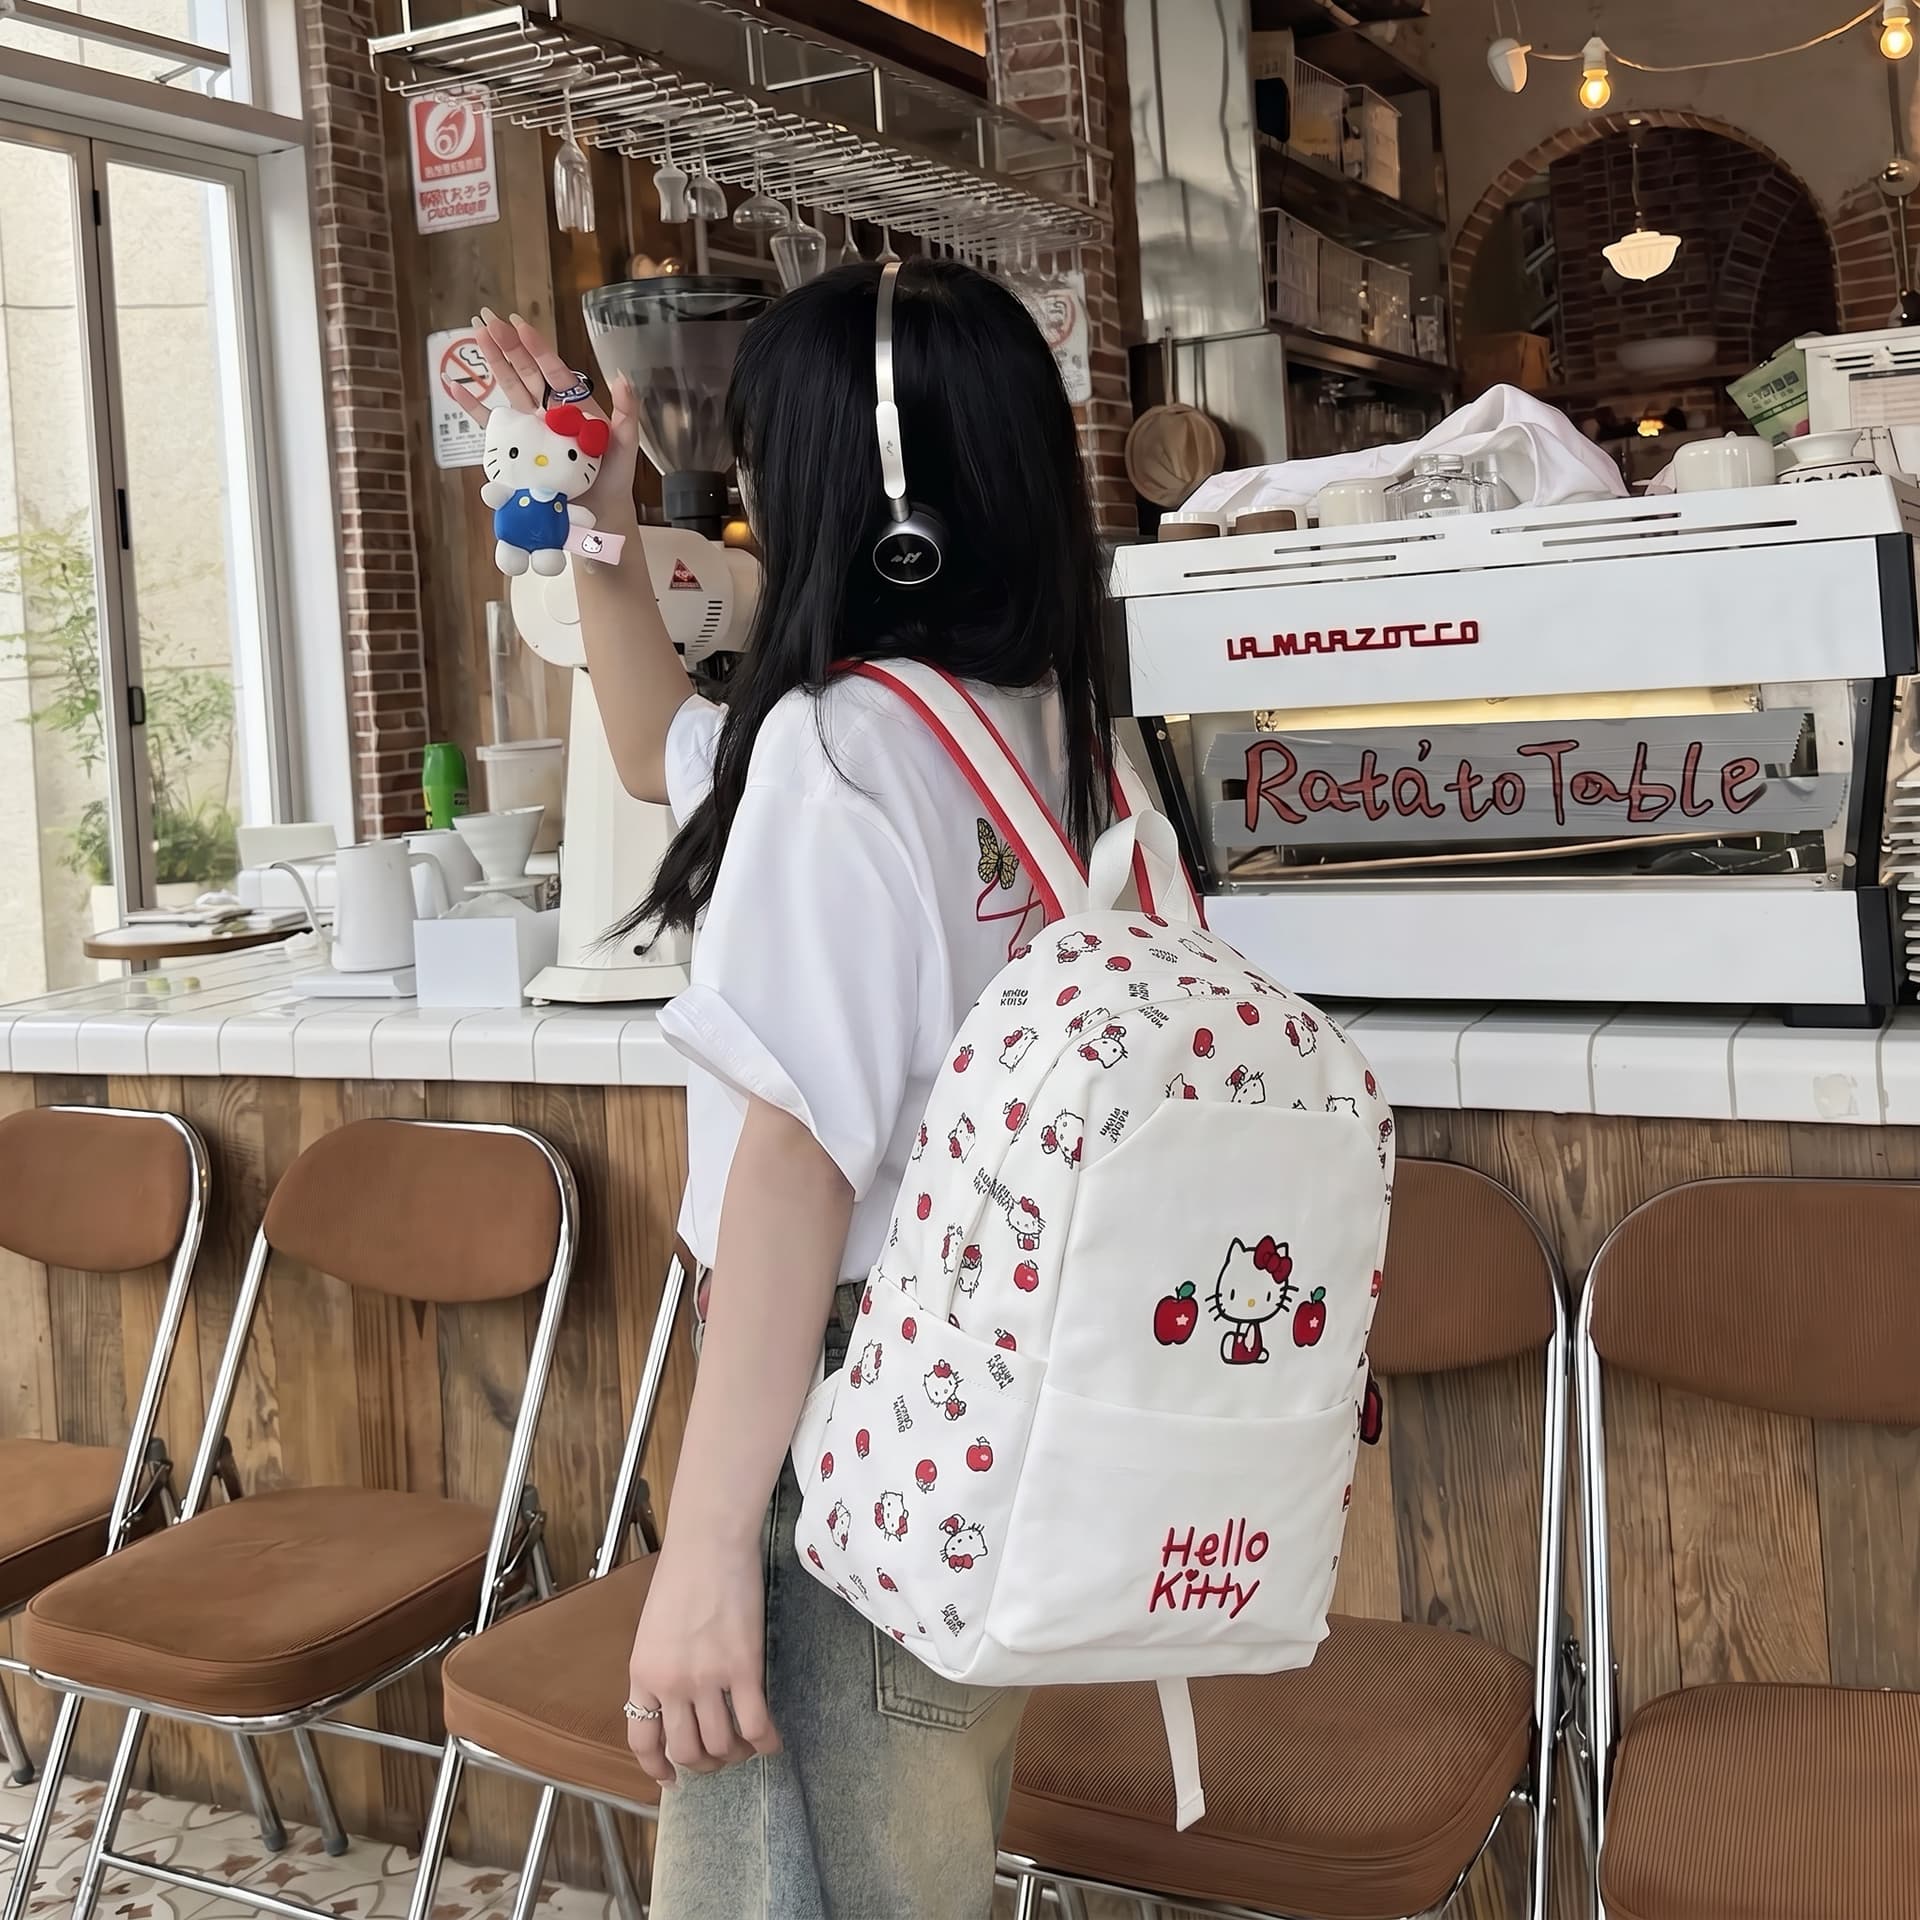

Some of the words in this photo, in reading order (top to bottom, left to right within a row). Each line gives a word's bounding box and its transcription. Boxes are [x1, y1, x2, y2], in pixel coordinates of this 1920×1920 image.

[1517, 739, 1768, 826] Table
[1162, 1517, 1269, 1567] Hello
[1149, 1568, 1260, 1619] Kitty
